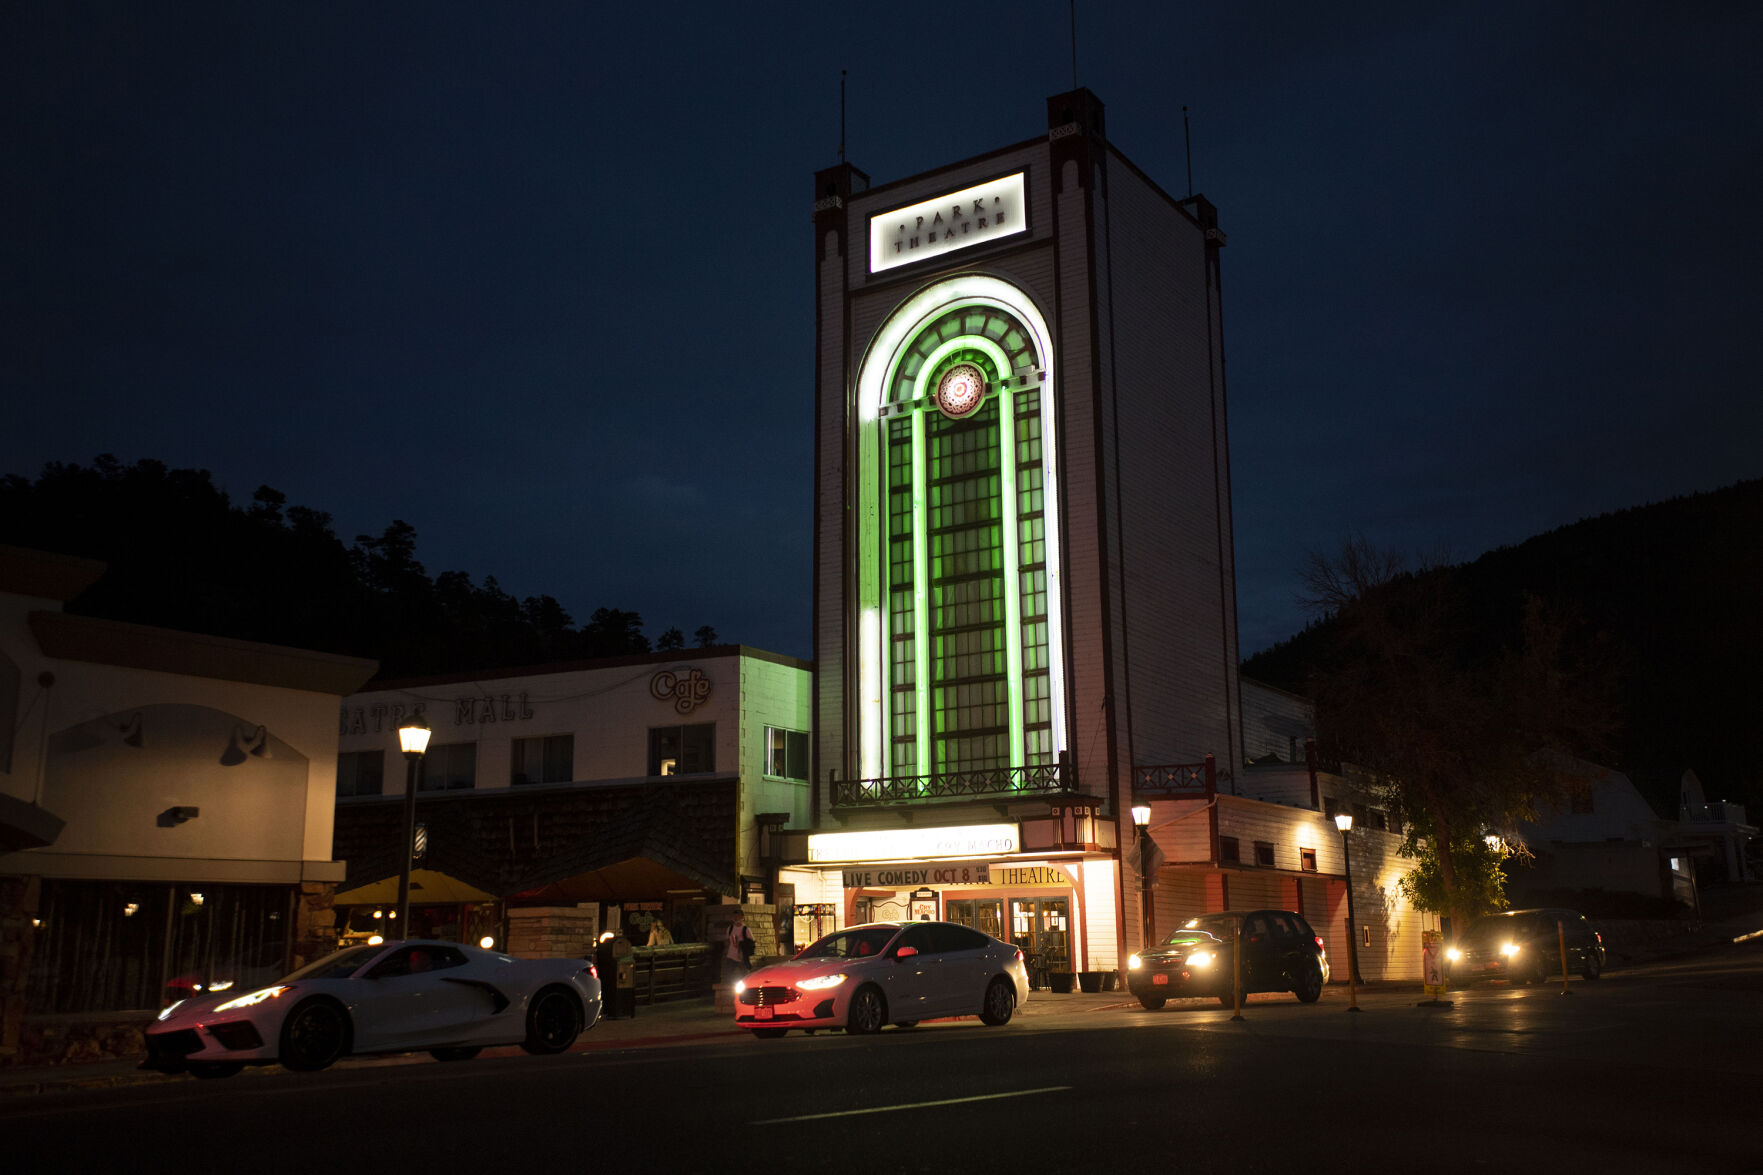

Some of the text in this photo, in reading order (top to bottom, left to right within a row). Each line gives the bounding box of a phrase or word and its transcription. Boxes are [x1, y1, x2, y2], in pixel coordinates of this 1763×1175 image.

[915, 197, 985, 230] PARK
[894, 211, 1006, 253] THEATRE
[455, 693, 534, 725] MALL
[968, 838, 1012, 850] MACHO
[843, 872, 872, 887] LIVE
[878, 869, 928, 885] COMEDY
[934, 868, 957, 883] OCT
[962, 868, 970, 882] 8
[1002, 867, 1065, 884] THEATRE
